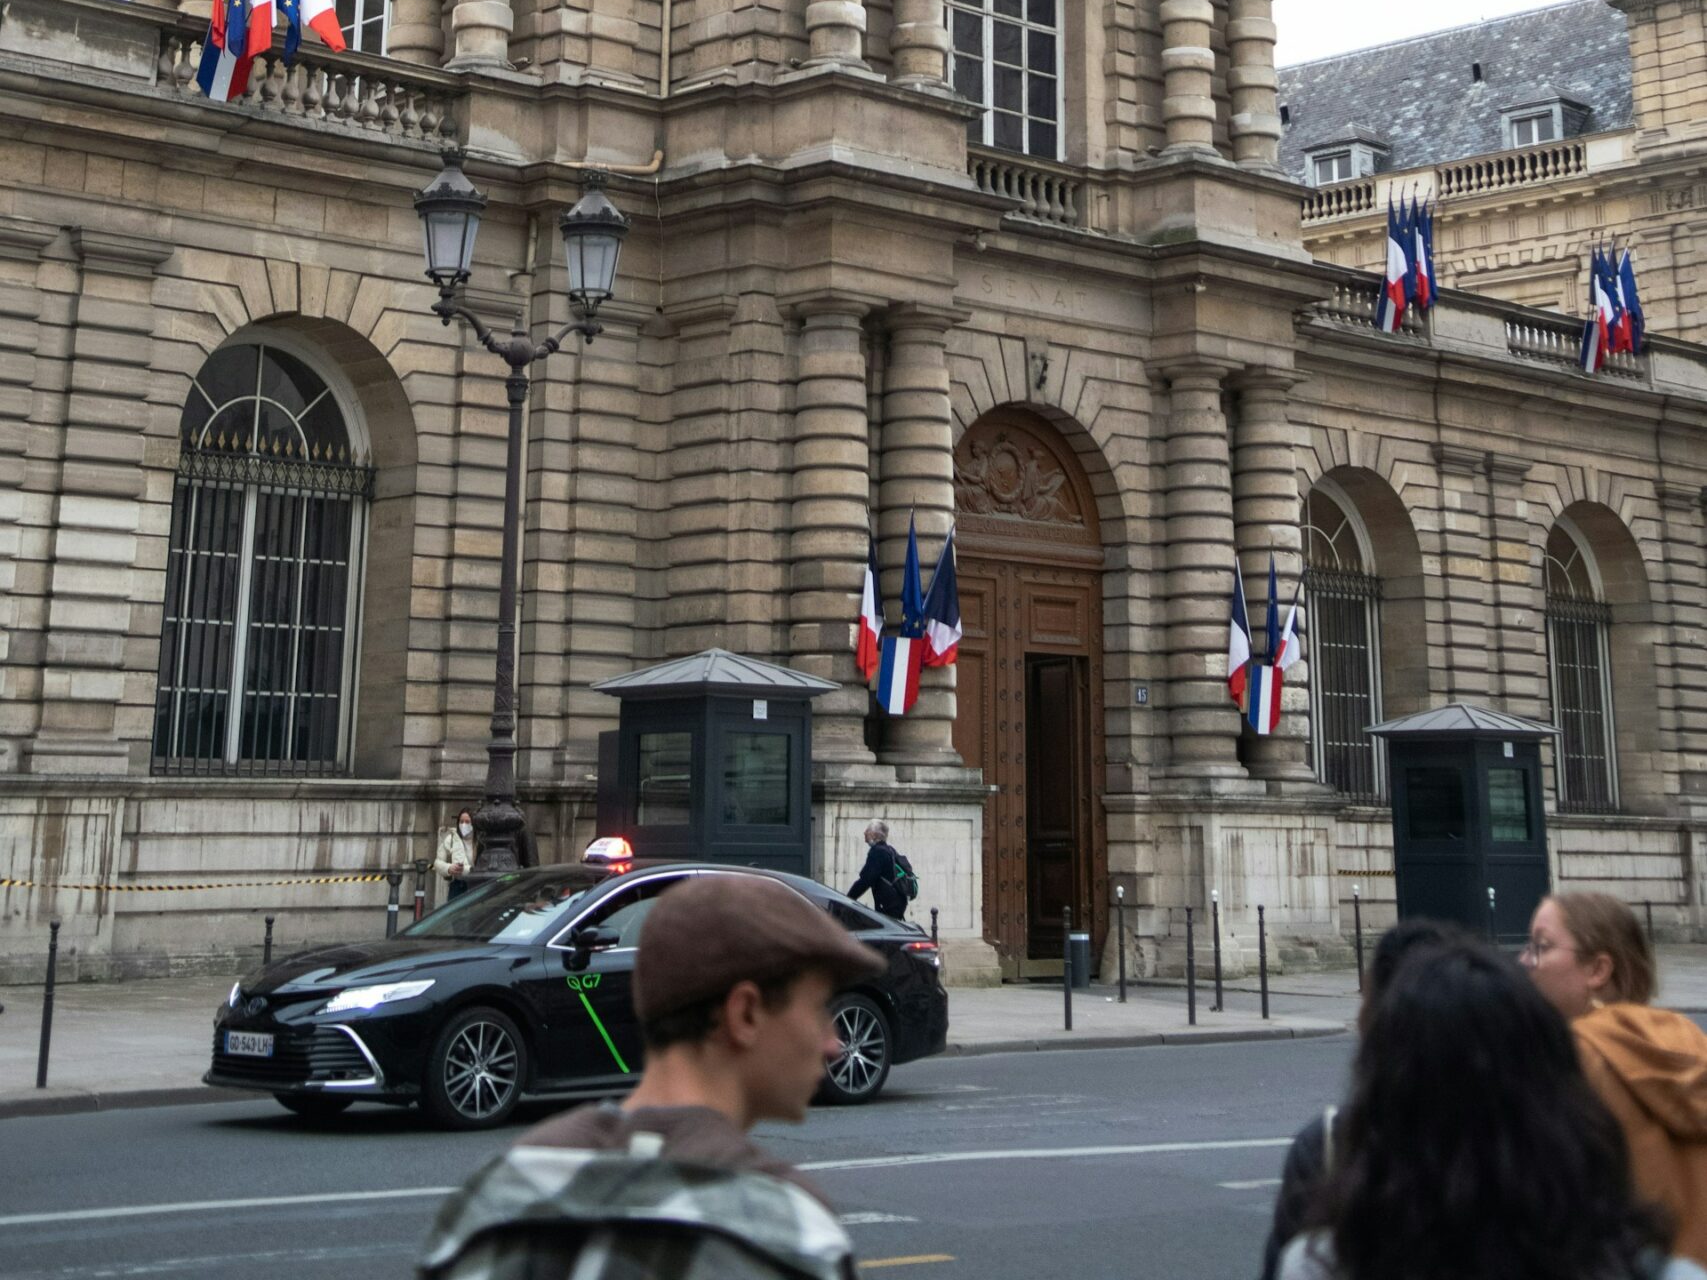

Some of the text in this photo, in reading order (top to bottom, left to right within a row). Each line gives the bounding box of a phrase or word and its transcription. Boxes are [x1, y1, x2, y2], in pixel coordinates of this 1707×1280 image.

[982, 274, 1087, 311] SENAT
[1138, 688, 1147, 702] 15
[582, 974, 601, 989] G7
